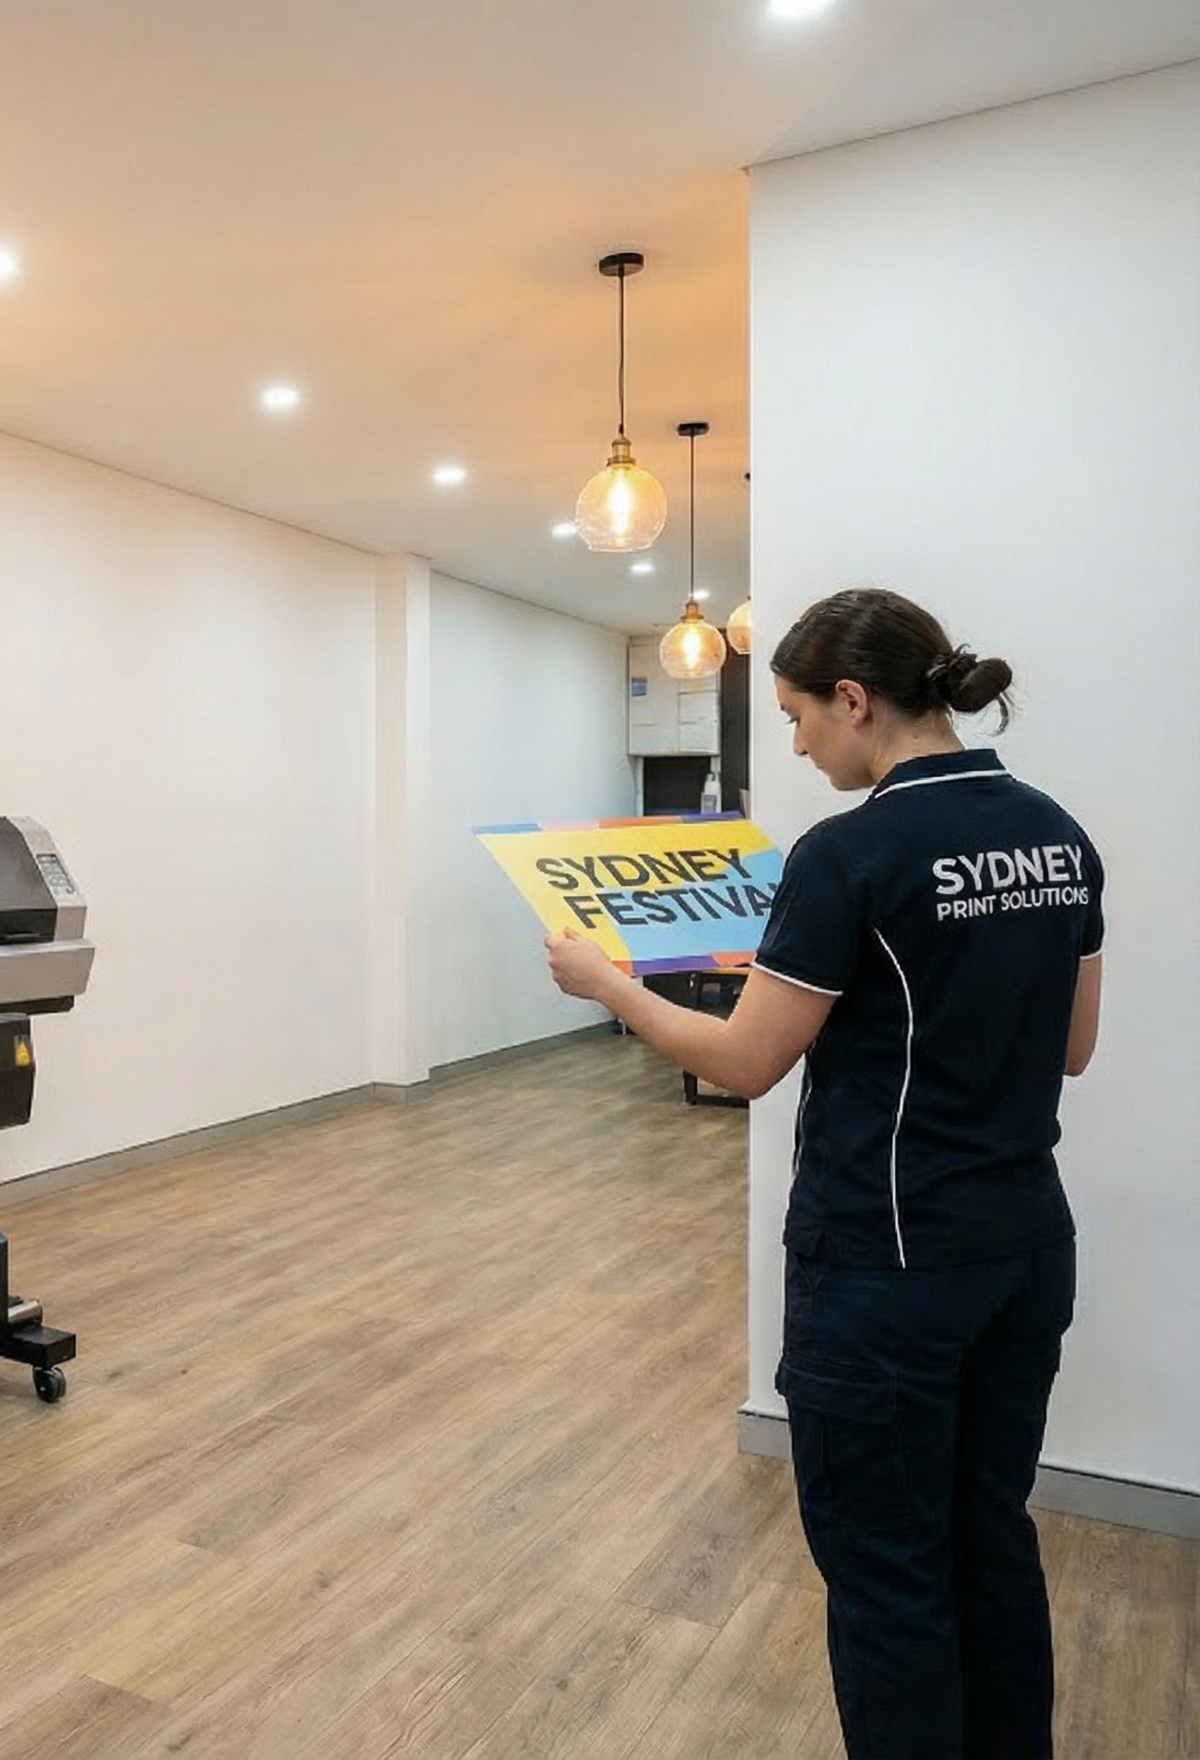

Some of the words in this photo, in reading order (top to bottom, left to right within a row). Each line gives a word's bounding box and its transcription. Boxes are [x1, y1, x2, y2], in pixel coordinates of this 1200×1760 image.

[535, 848, 753, 891] SYDNEY
[931, 843, 1083, 896] SYDNEY
[562, 882, 778, 930] FESTIVA
[936, 894, 997, 922] PRINT
[1001, 886, 1089, 912] SOLUTIONS
